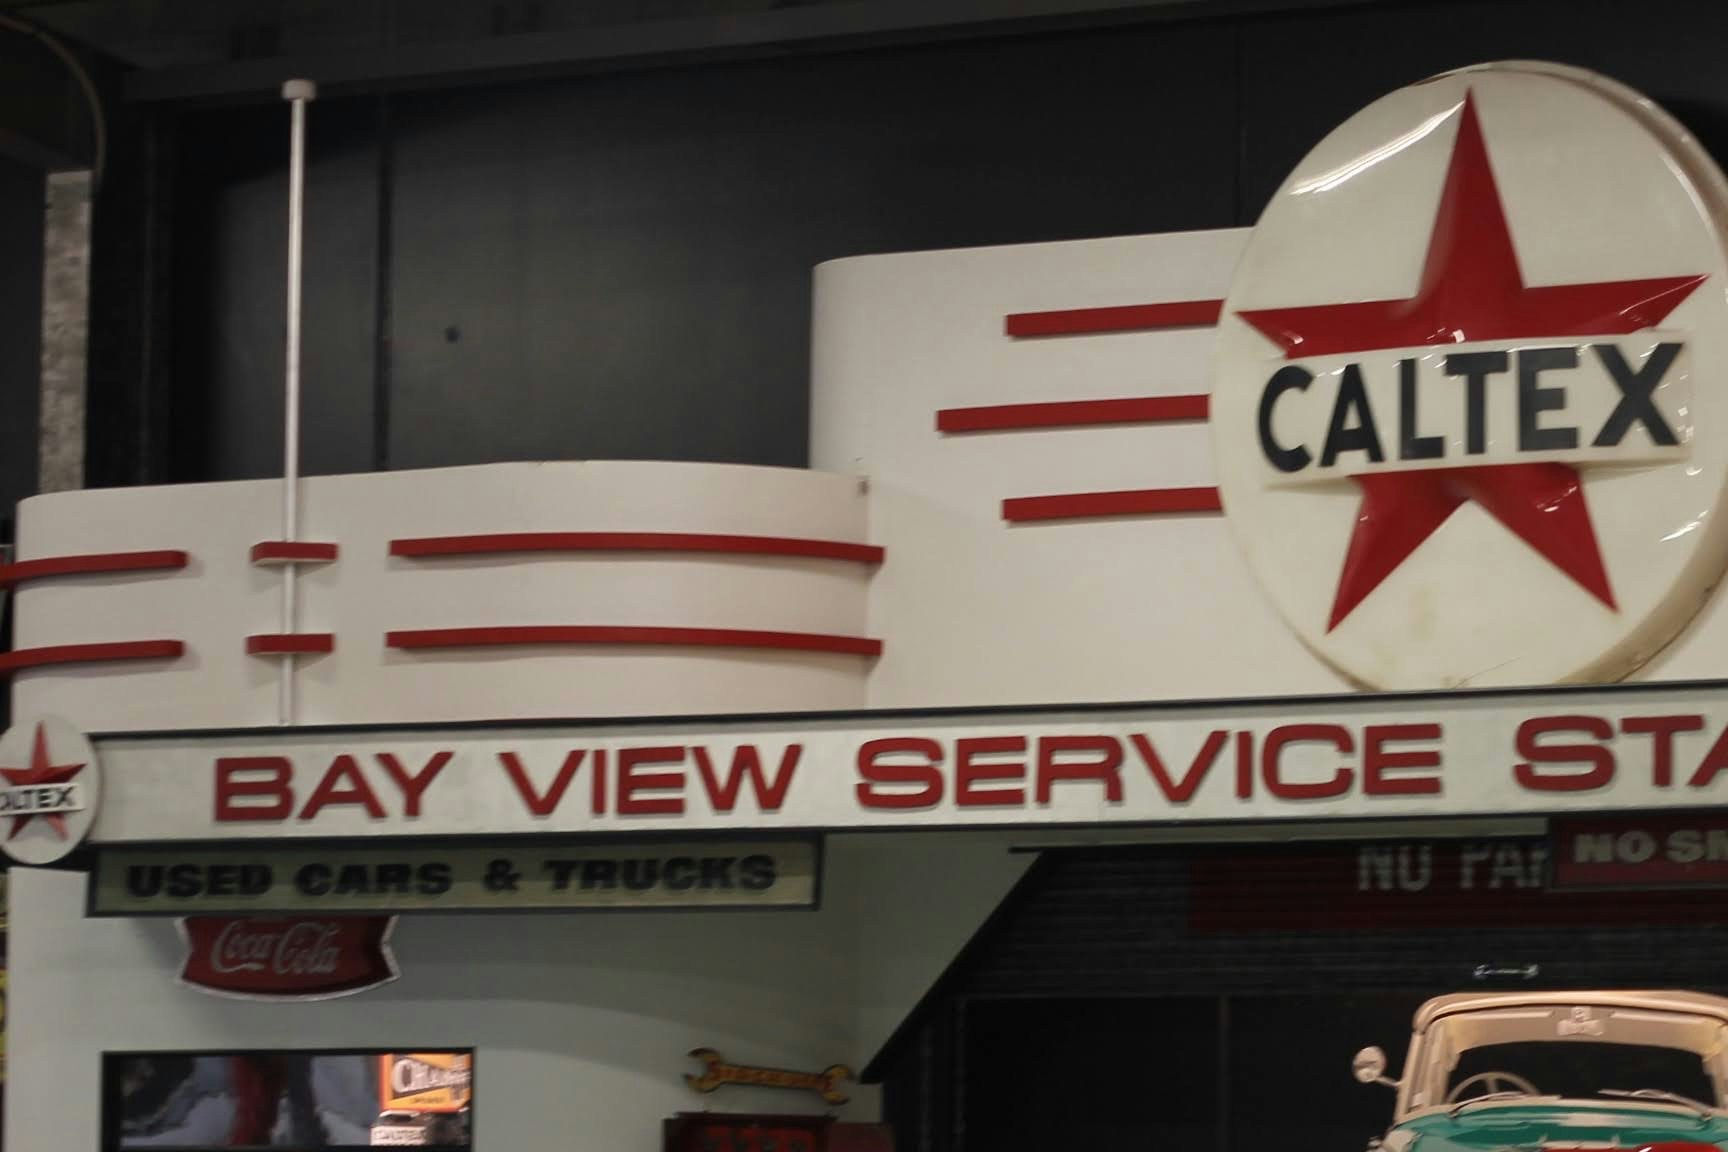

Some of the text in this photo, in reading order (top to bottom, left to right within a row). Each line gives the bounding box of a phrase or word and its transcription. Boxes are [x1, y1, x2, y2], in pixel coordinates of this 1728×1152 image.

[1257, 341, 1686, 473] CALTEX
[213, 751, 456, 823] BAY
[497, 744, 804, 818] VIEW
[854, 723, 1444, 810] SERVICE
[1357, 844, 1433, 892] NO
[1574, 830, 1656, 864] NO
[125, 854, 778, 898] USED CARS & TRUCKS
